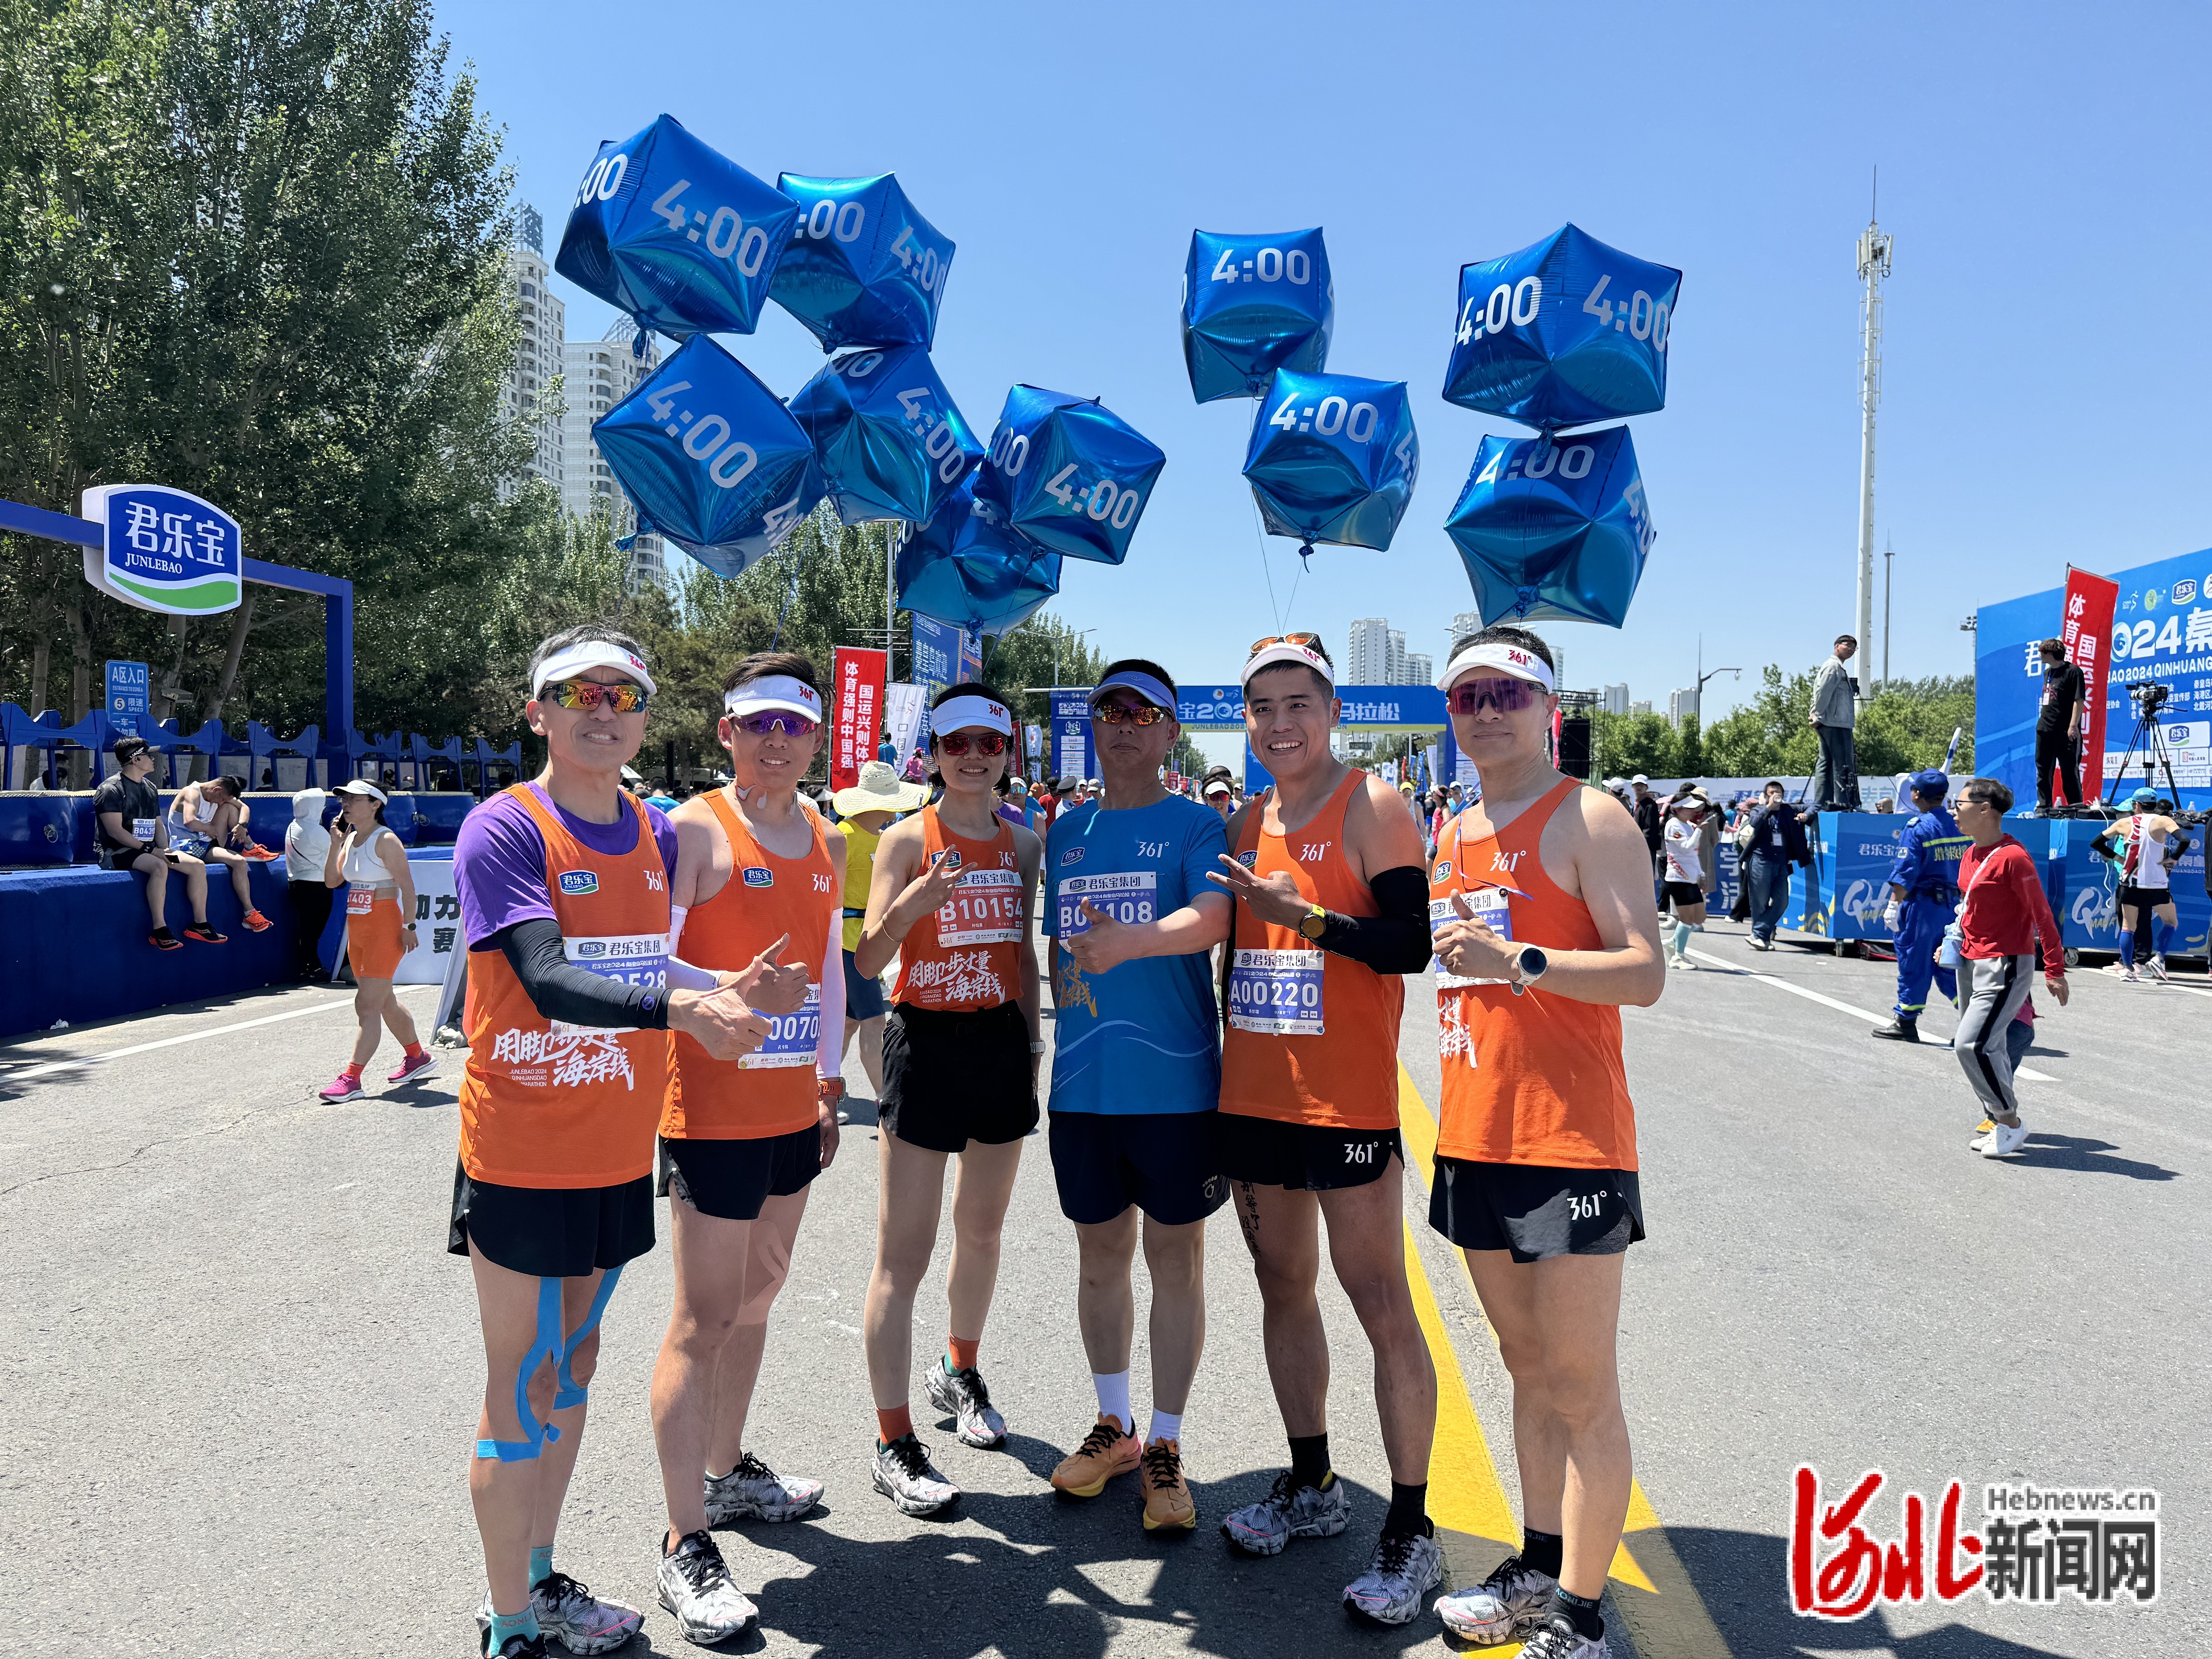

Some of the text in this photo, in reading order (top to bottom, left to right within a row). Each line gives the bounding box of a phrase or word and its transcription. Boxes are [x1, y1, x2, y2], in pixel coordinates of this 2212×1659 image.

[575, 154, 628, 208] :00
[652, 179, 768, 277] 4:00
[795, 199, 865, 242] :00
[1211, 248, 1310, 284] 4:00
[1456, 276, 1542, 345] 4:00
[1583, 274, 1669, 352] 4:00
[830, 352, 884, 377] 00
[1269, 393, 1378, 443] 4:00
[646, 381, 757, 488] 4:00
[896, 387, 965, 484] 4:00
[984, 419, 1029, 476] :00
[1475, 445, 1595, 485] 4:00
[1045, 463, 1138, 529] 4:00
[125, 501, 225, 567] 君乐宝
[125, 553, 182, 574] JUNLEBAO
[112, 666, 144, 684] A区入口
[2126, 666, 2152, 682] 2024
[117, 699, 122, 708] 5
[128, 697, 143, 707] 限速
[841, 661, 859, 768] 体育强则中国强
[1137, 842, 1169, 858] 361°
[1300, 841, 1331, 861] 361°
[1489, 850, 1526, 872] 361°
[563, 874, 593, 885] 君乐宝
[747, 870, 769, 879] 君乐宝
[970, 873, 1015, 884] 君乐宝集团
[1089, 876, 1140, 890] 君乐宝集团
[939, 897, 1023, 922] B10154
[1061, 901, 1152, 928] B0108
[609, 940, 660, 955] 君乐宝集团
[1253, 954, 1306, 967] 君乐宝集团
[906, 950, 992, 988] 用脚步丈量
[945, 973, 1006, 1004] 海岸线
[1231, 980, 1318, 1007] A00220
[553, 1047, 635, 1091] 海岸线
[1345, 1142, 1378, 1163] 361°
[1567, 1191, 1607, 1220] 361°
[1556, 1587, 1593, 1609] AONIJIE
